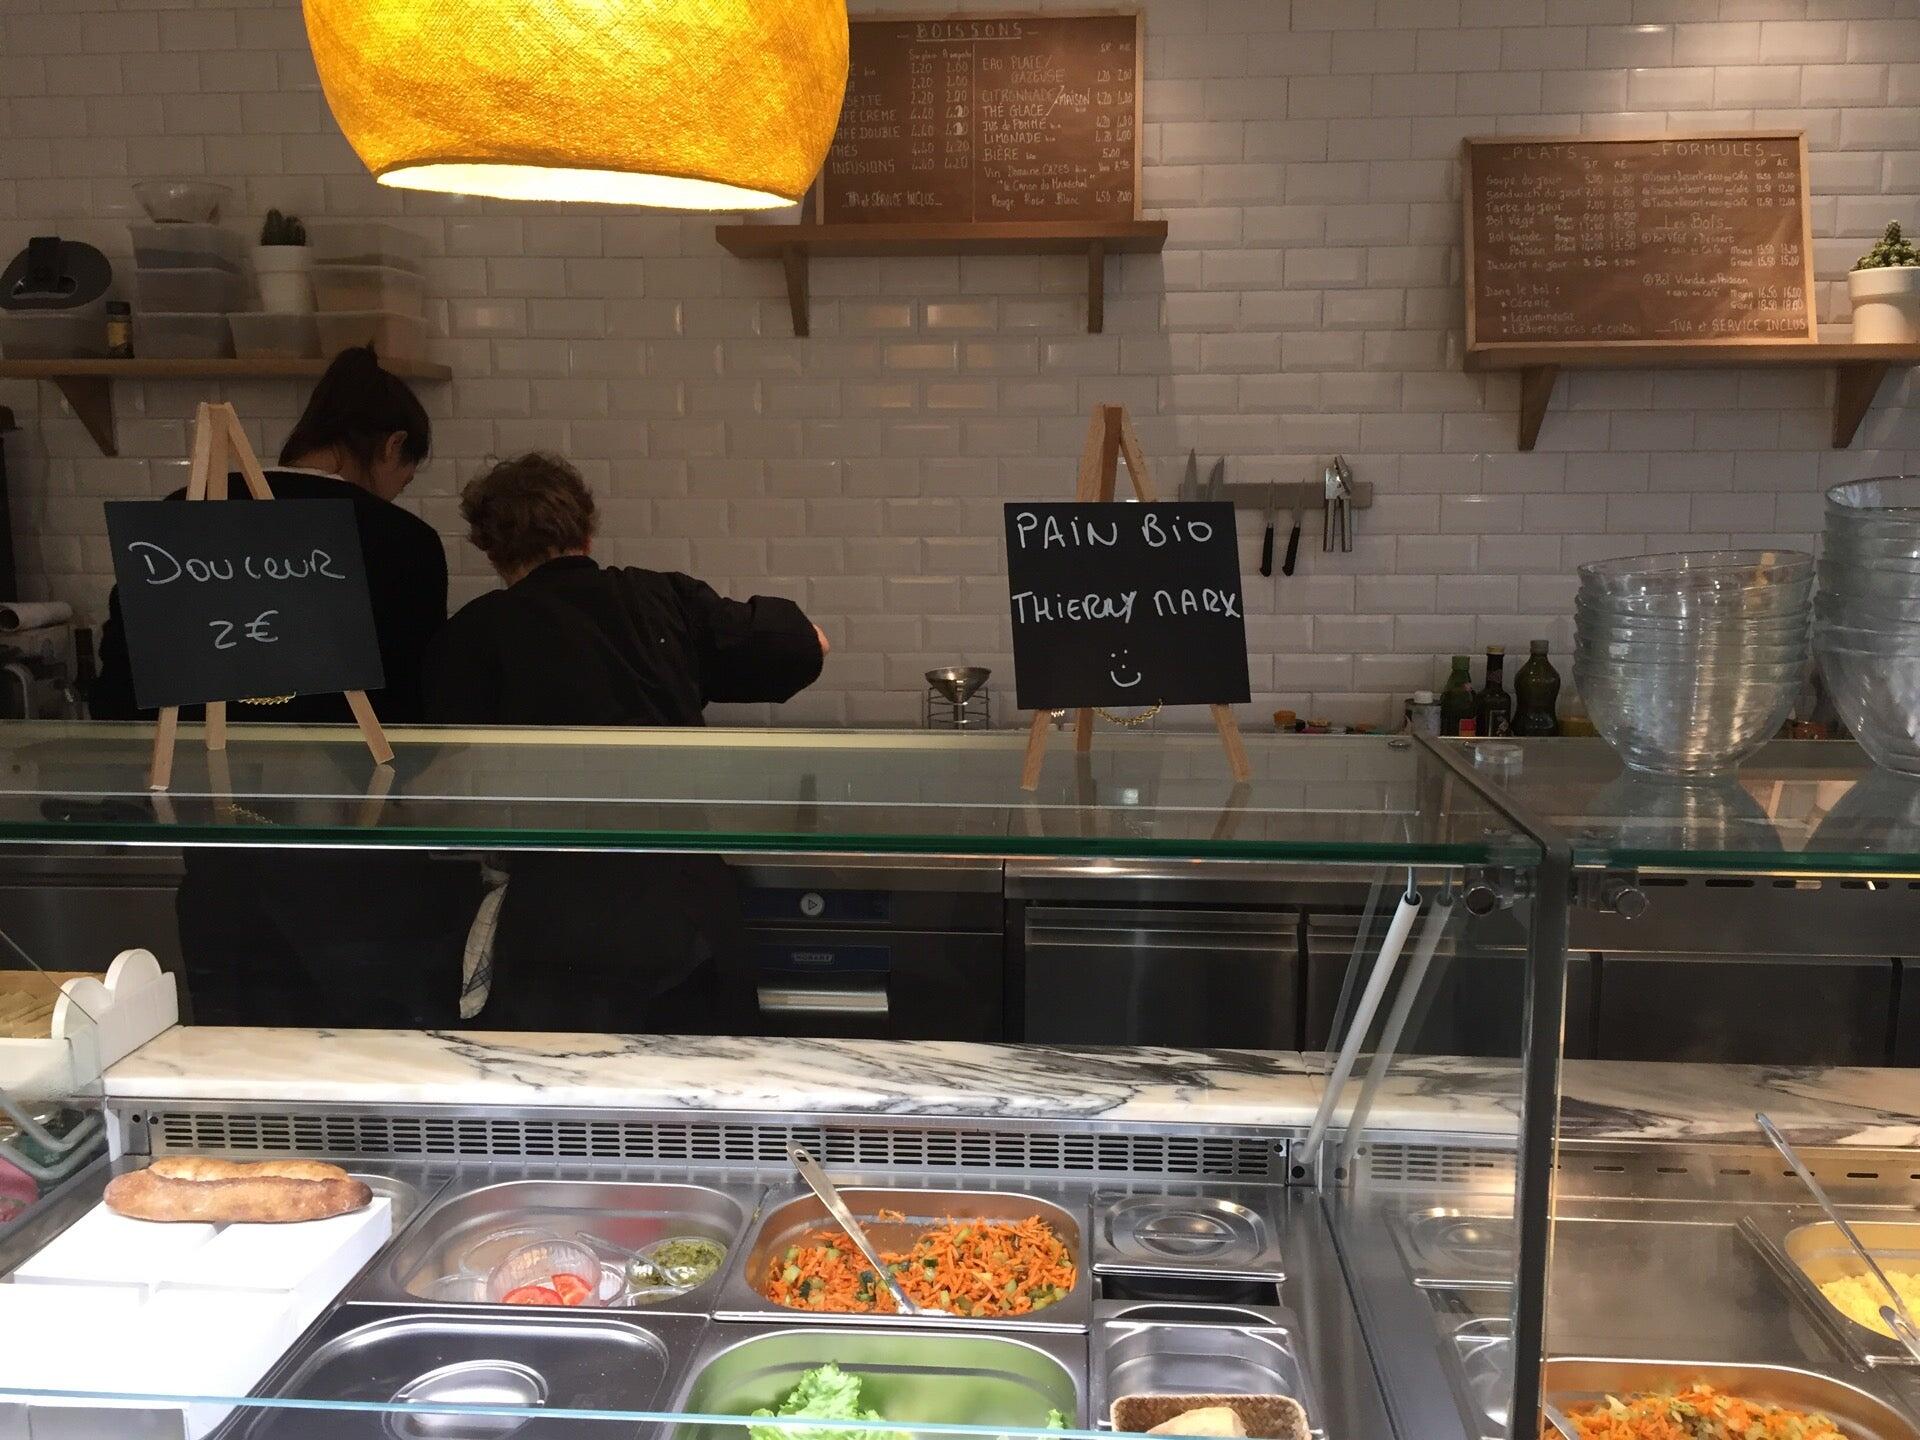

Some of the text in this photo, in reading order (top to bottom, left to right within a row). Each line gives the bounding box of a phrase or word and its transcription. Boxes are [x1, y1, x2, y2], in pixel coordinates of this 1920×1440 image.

[916, 22, 1022, 39] BOISSONS
[1010, 68, 1065, 83] GAZEUSE
[982, 103, 1004, 117] THÉ
[860, 125, 901, 139] DOUBLE
[984, 131, 1042, 145] LIMONADE
[1513, 146, 1578, 159] PLATS
[1662, 142, 1765, 157] FORMULES
[832, 158, 895, 175] INFUSIONS
[1690, 211, 1725, 230] Bols
[1711, 317, 1760, 333] SERVICE
[1765, 317, 1807, 332] INCLUS
